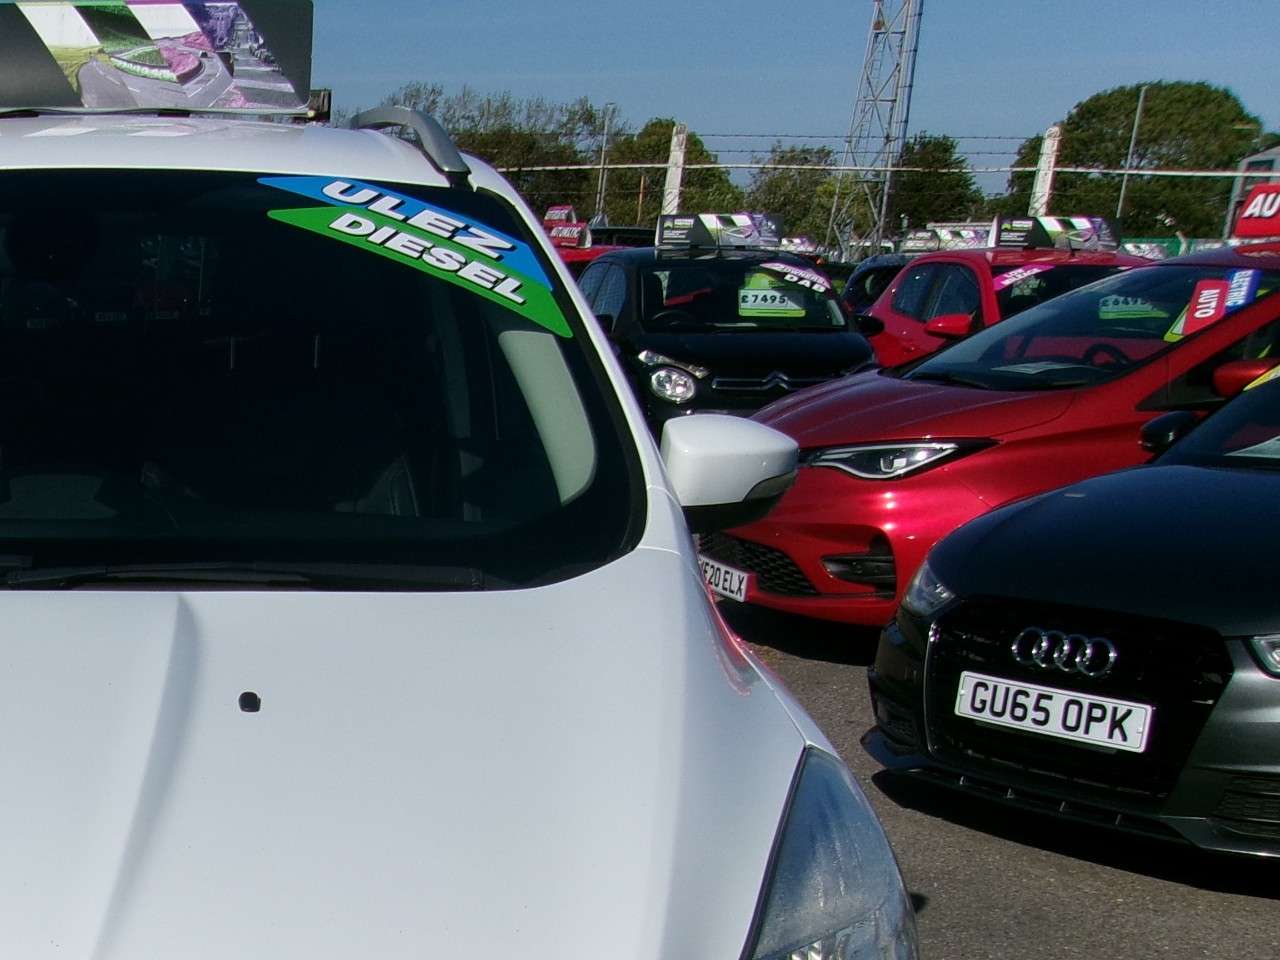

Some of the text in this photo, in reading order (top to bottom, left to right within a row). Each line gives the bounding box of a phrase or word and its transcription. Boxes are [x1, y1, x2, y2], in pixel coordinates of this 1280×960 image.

[322, 181, 515, 260] ULEZ
[329, 212, 527, 304] DIESEL
[784, 273, 826, 293] DAB
[1194, 289, 1221, 319] AUTO
[722, 570, 745, 598] ELX
[970, 681, 1132, 743] GU65 OPK
